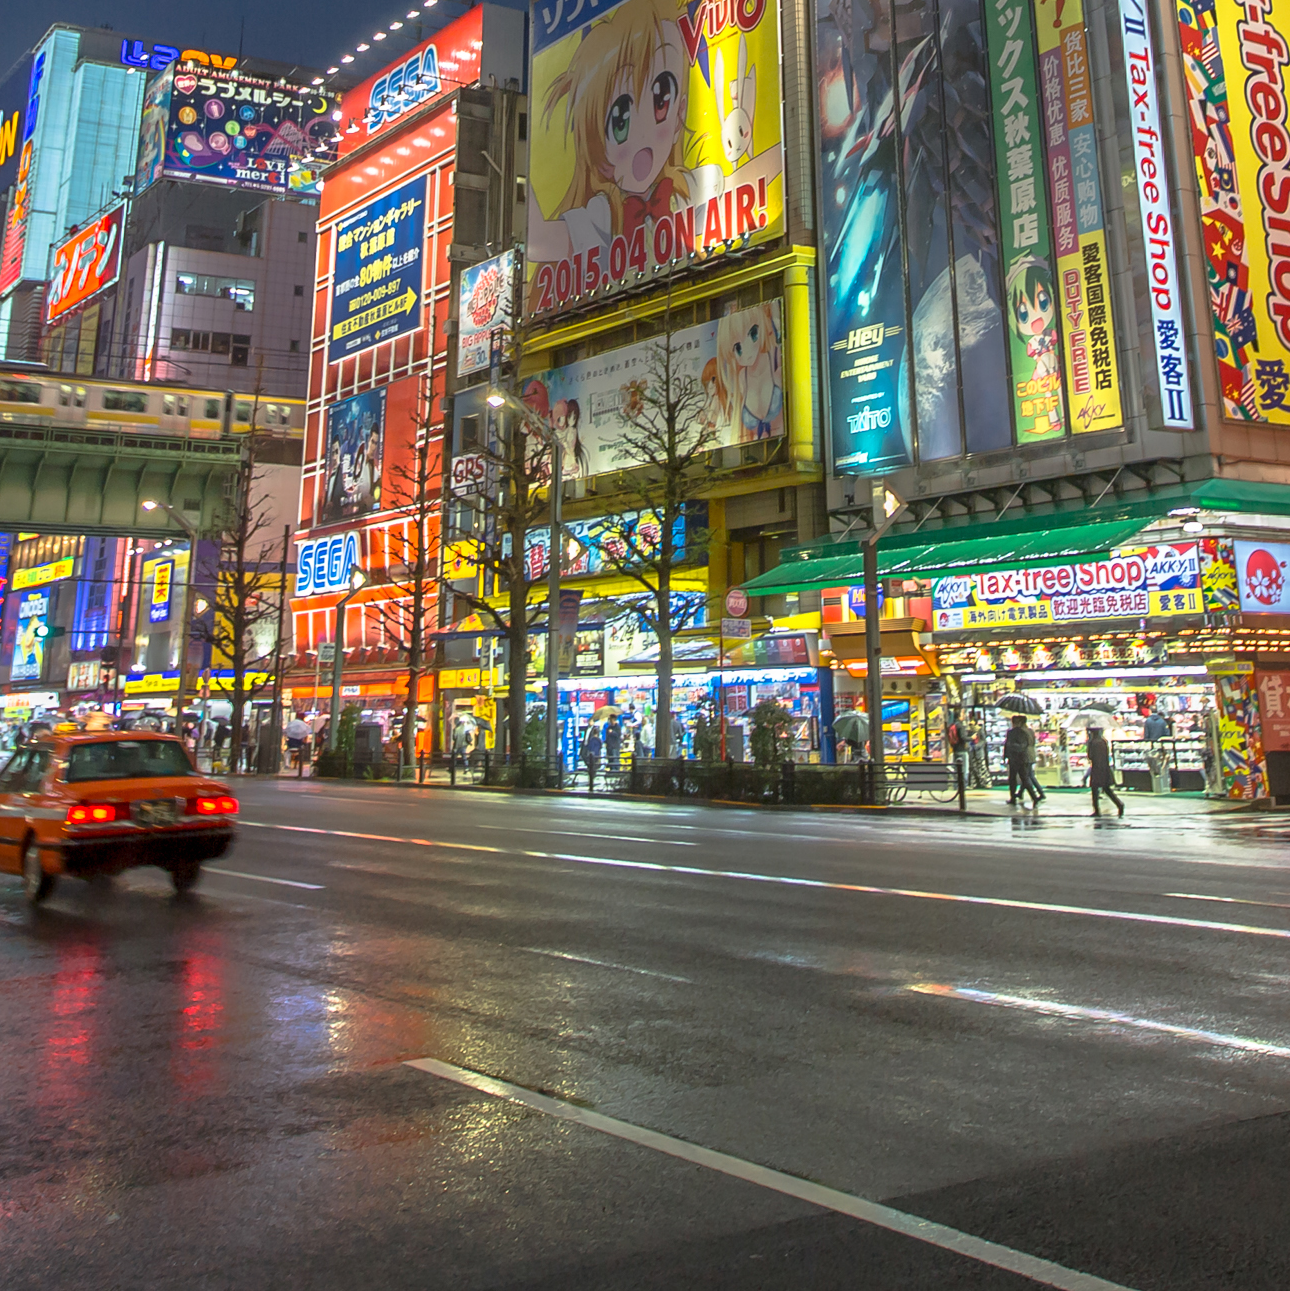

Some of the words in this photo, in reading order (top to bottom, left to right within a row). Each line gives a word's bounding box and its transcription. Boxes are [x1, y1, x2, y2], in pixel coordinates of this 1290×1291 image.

[197, 78, 305, 107] ラブメルシー
[367, 43, 442, 136] SEGA
[1063, 28, 1091, 122] 货比三家
[1051, 155, 1076, 252] 优质服务
[1071, 131, 1100, 230] 安心购物
[1128, 46, 1161, 213] Tax-free
[1145, 214, 1173, 313] Shop
[536, 221, 648, 314] 2015.04
[652, 206, 696, 267] ON
[701, 176, 769, 248] AIR!
[1063, 269, 1084, 330] DUTY
[846, 323, 885, 353] Hey
[1069, 331, 1091, 395] FREE
[1016, 375, 1061, 399] このビル
[846, 405, 892, 434] TAITO
[295, 531, 361, 596] SEGA
[973, 567, 1071, 598] Tax-free
[1076, 557, 1144, 590] Shop
[967, 604, 1049, 624] 海外向け電気製品
